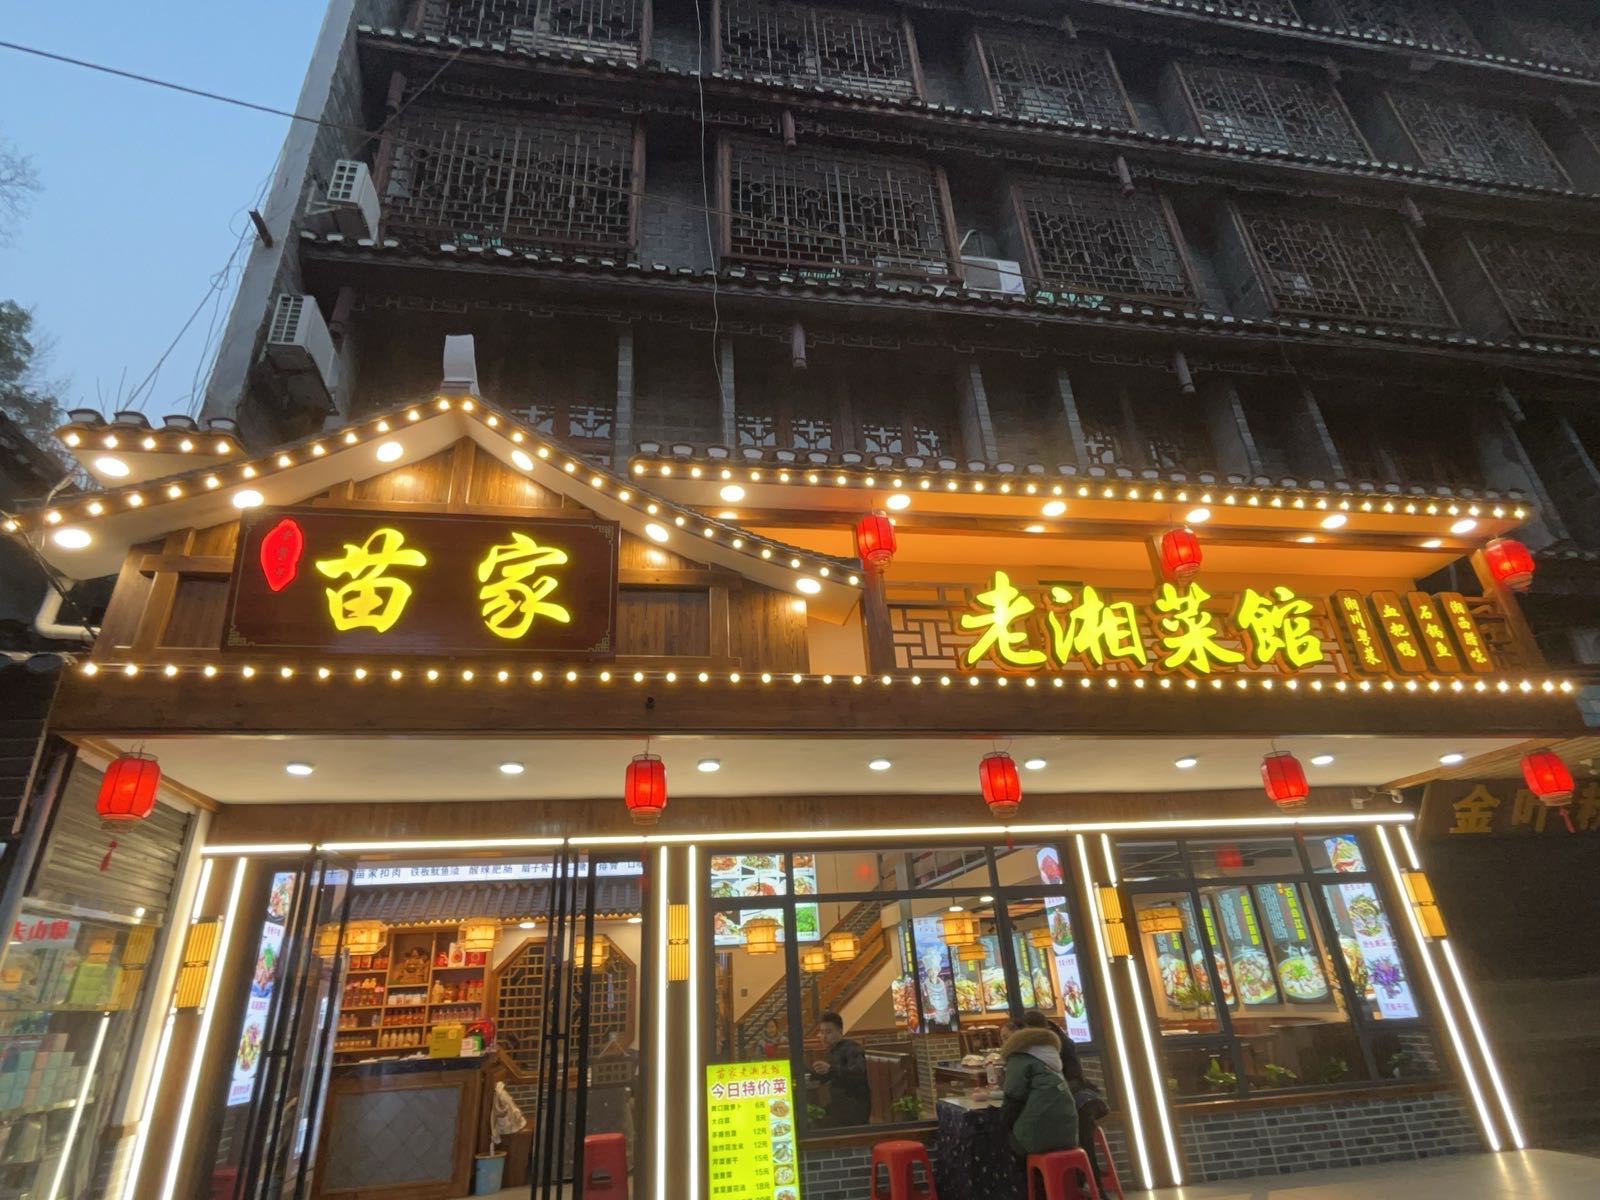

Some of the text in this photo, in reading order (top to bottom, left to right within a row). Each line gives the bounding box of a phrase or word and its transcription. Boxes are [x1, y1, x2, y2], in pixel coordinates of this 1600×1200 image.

[315, 528, 571, 640] 苗家
[711, 1079, 786, 1098] 今日特价菜
